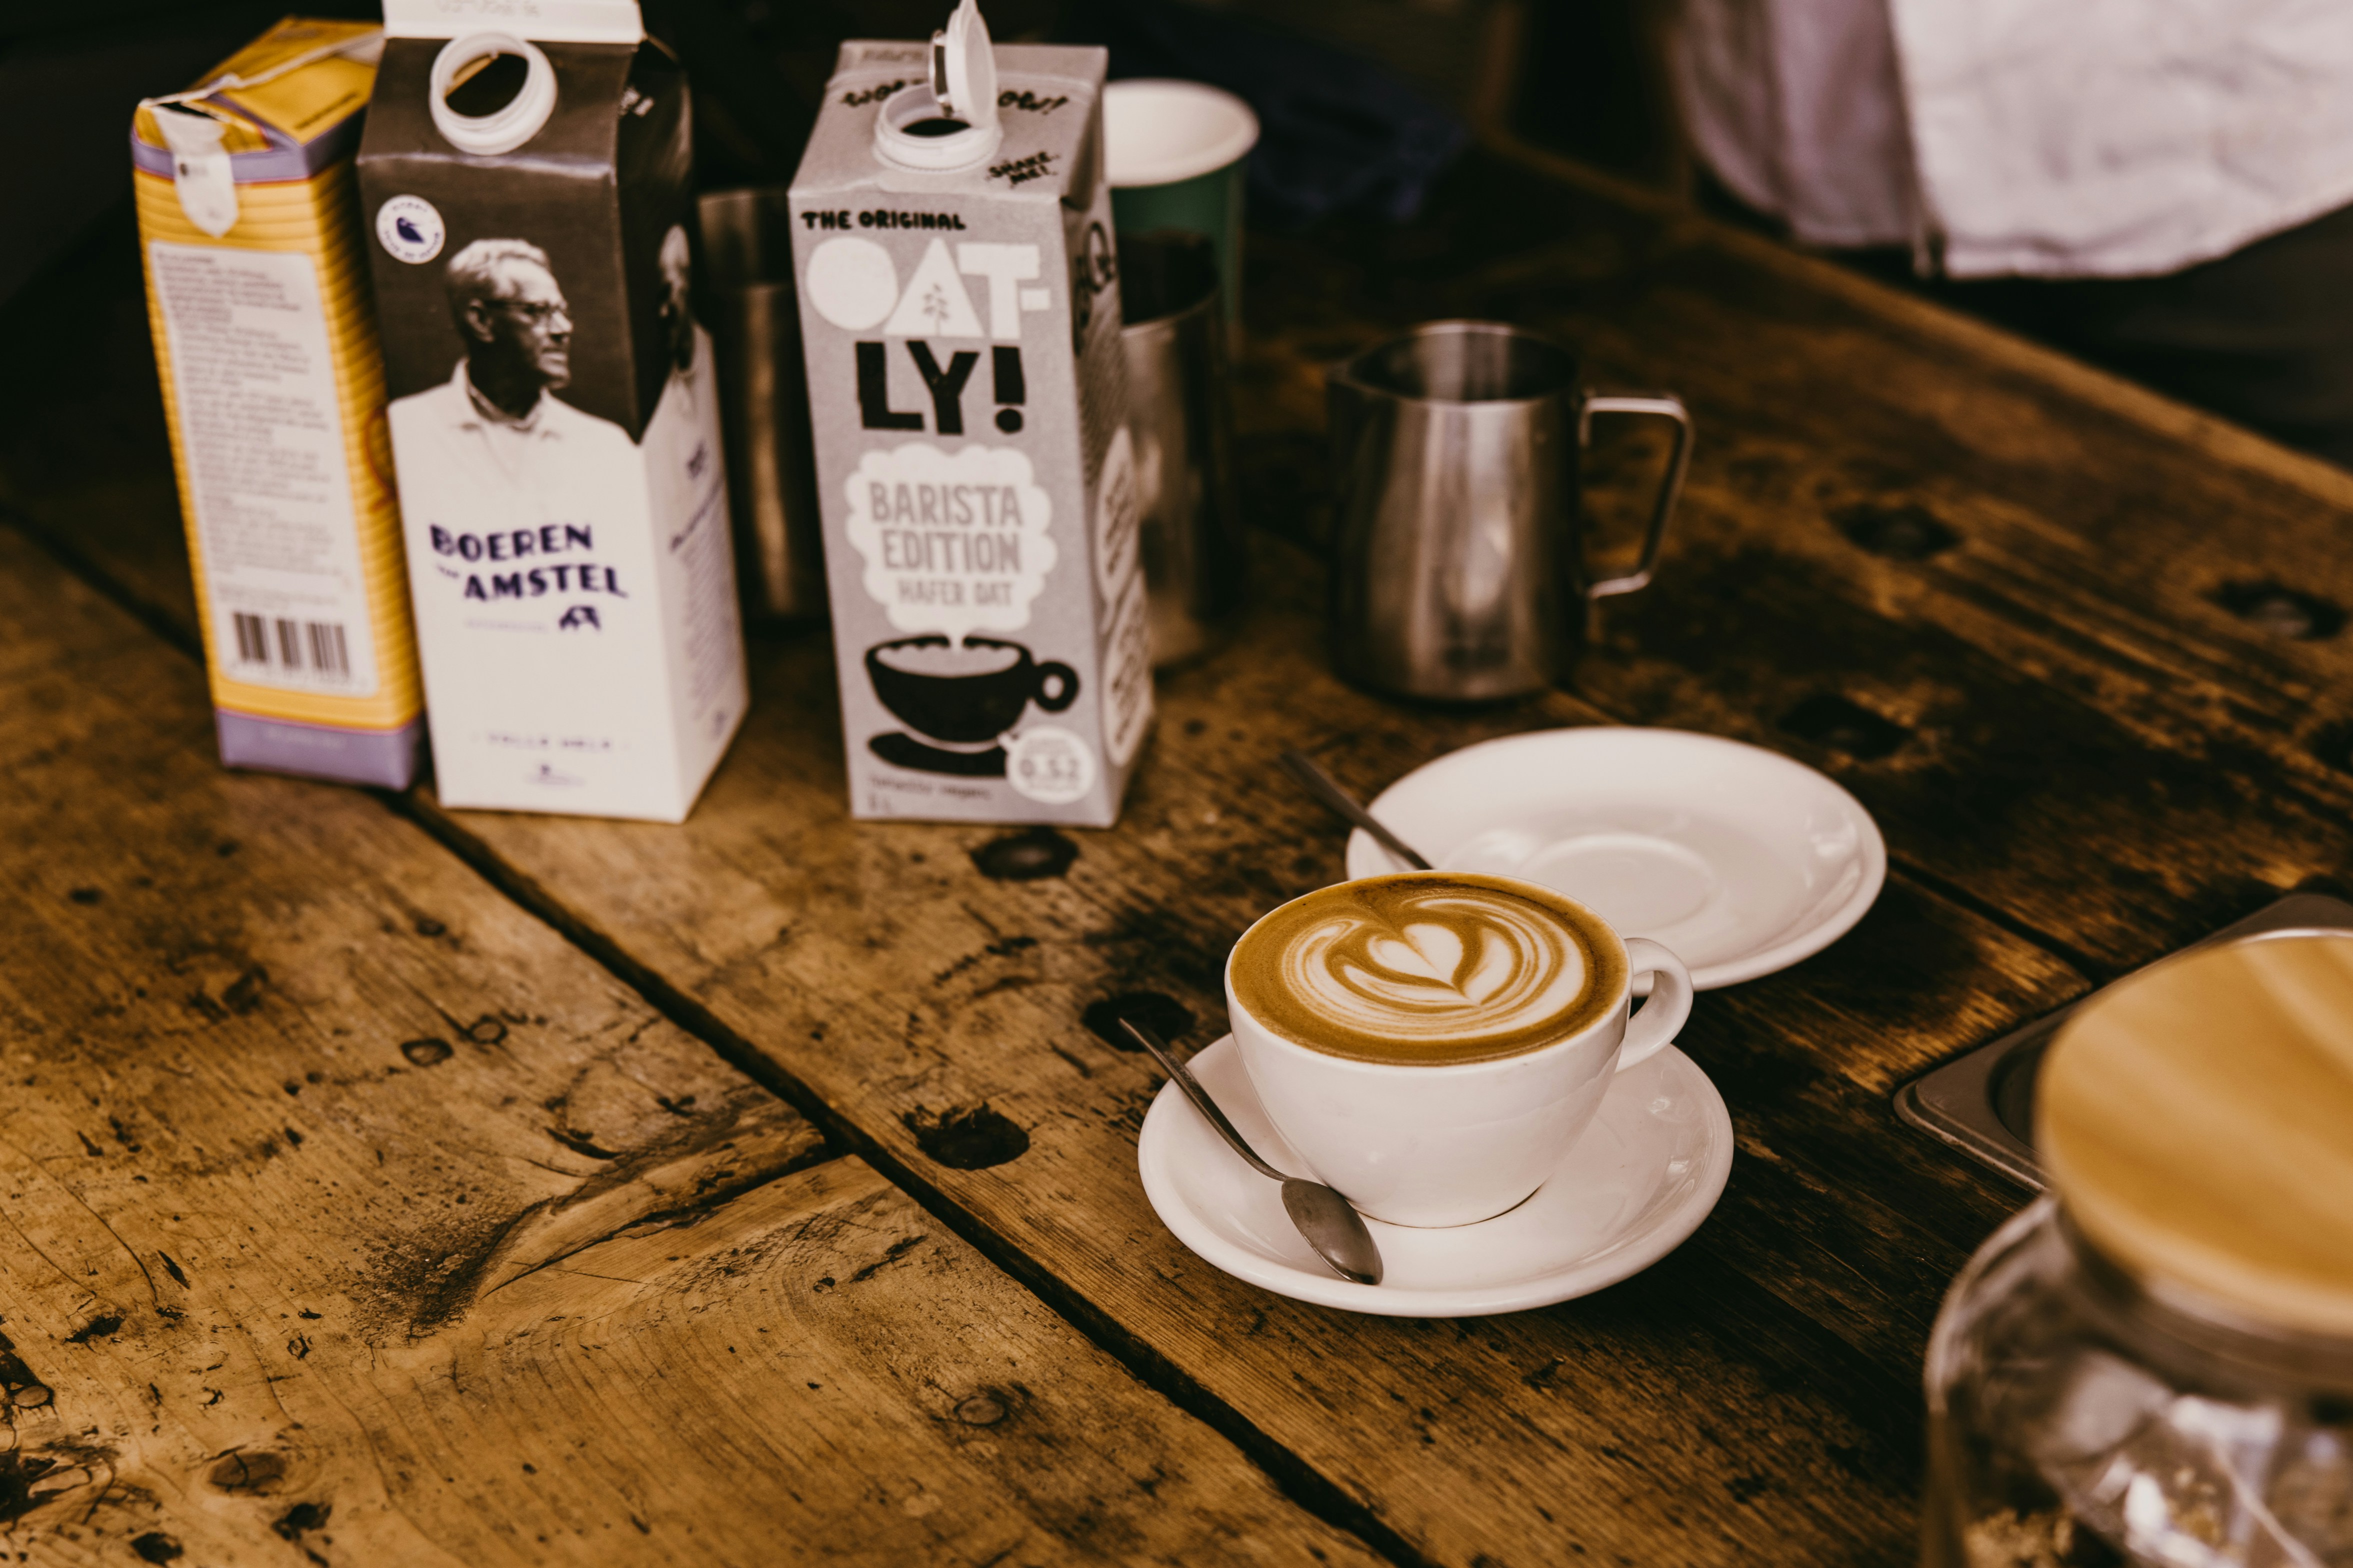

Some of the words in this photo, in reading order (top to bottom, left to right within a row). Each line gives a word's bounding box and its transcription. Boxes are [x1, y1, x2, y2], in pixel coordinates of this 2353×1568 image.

[800, 210, 852, 230] THE
[858, 209, 966, 231] ORIGINAL
[805, 235, 1051, 340] OAT-
[854, 340, 1026, 436] LY!
[868, 481, 1024, 527] BARISTA
[430, 523, 593, 563] BOEREN
[880, 529, 1021, 572] EDITION
[464, 563, 630, 601] AMSTEL
